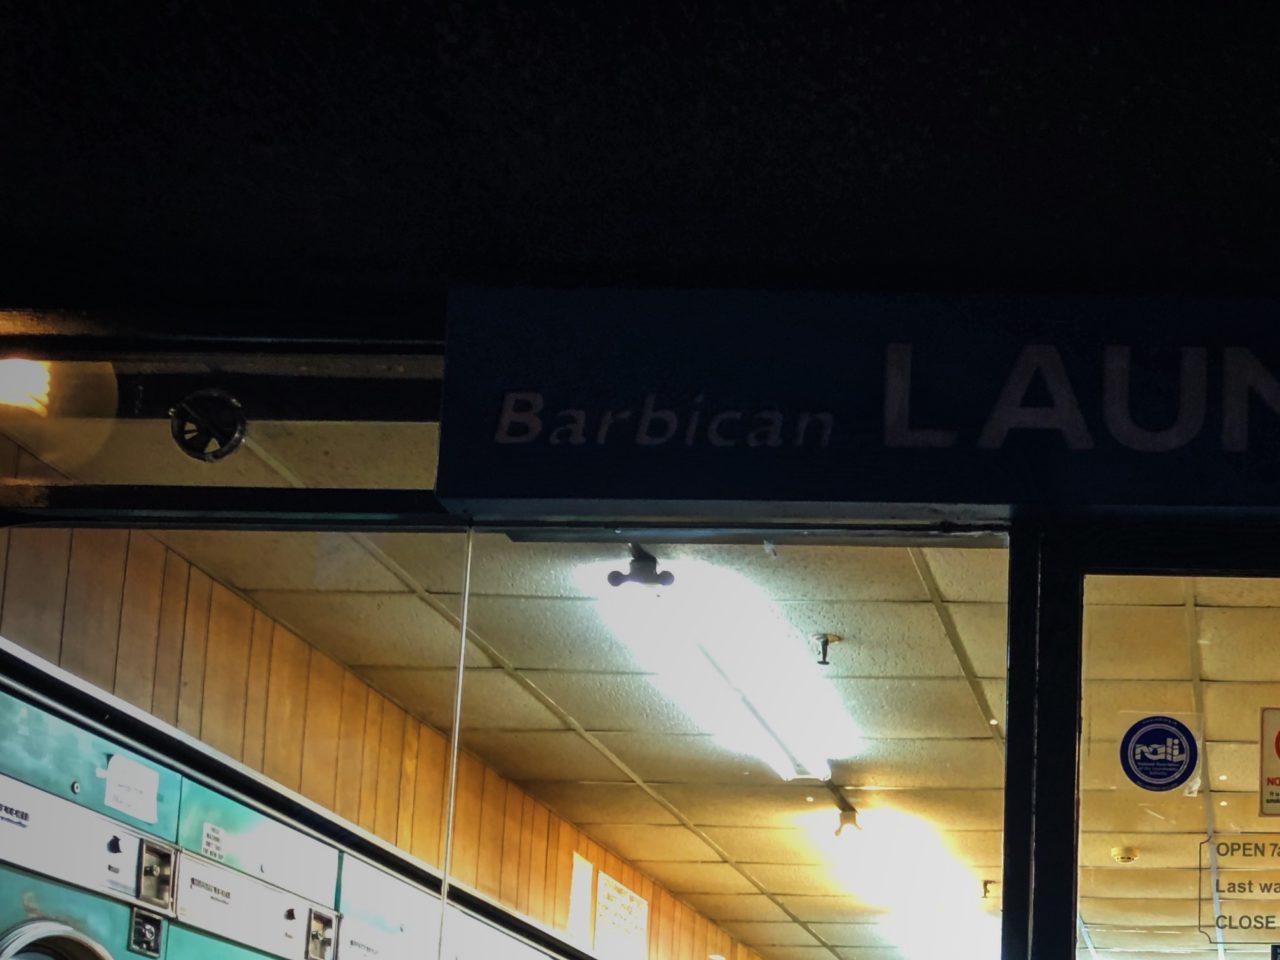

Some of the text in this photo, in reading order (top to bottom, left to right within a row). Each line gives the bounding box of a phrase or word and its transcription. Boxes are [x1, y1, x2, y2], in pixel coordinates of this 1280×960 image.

[493, 390, 834, 449] Barbican
[1267, 777, 1280, 787] NO
[1216, 843, 1266, 858] OPEN
[1215, 879, 1254, 894] Last
[1215, 915, 1276, 930] CLOSE
